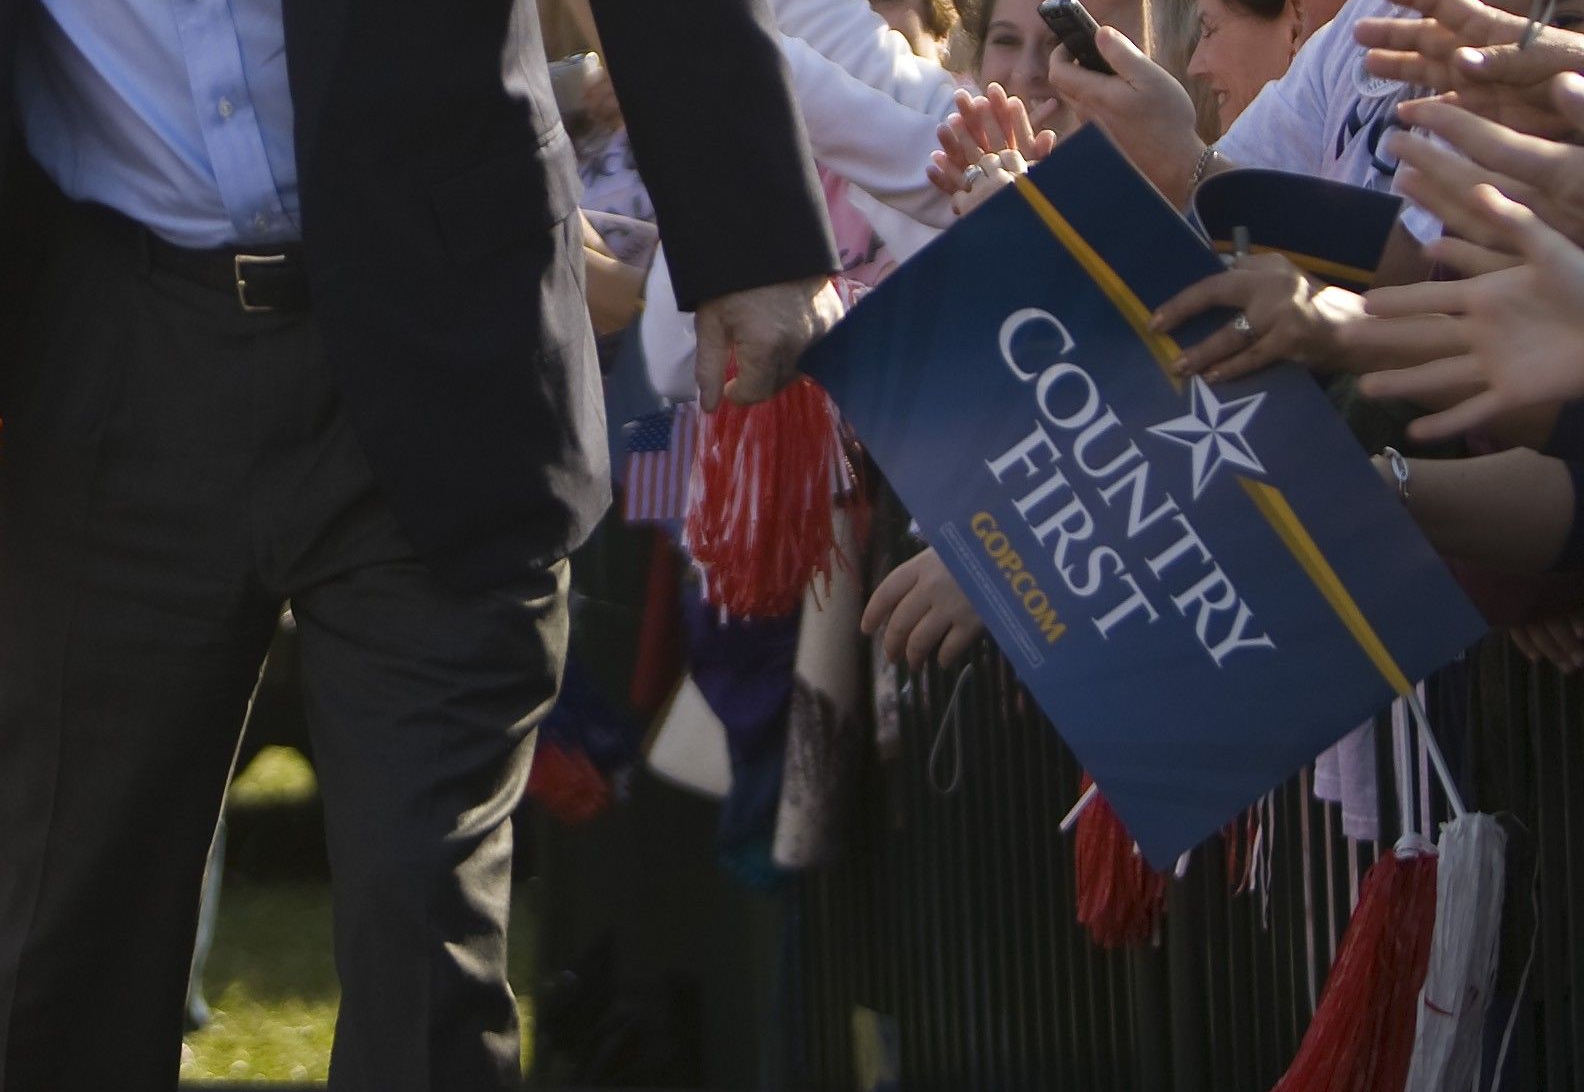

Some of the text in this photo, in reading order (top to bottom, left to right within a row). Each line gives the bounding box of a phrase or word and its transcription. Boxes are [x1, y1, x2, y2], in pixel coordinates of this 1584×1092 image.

[971, 512, 1066, 645] GOP.COM
[985, 420, 1160, 640] FIRST
[998, 307, 1277, 668] COUNTRY
